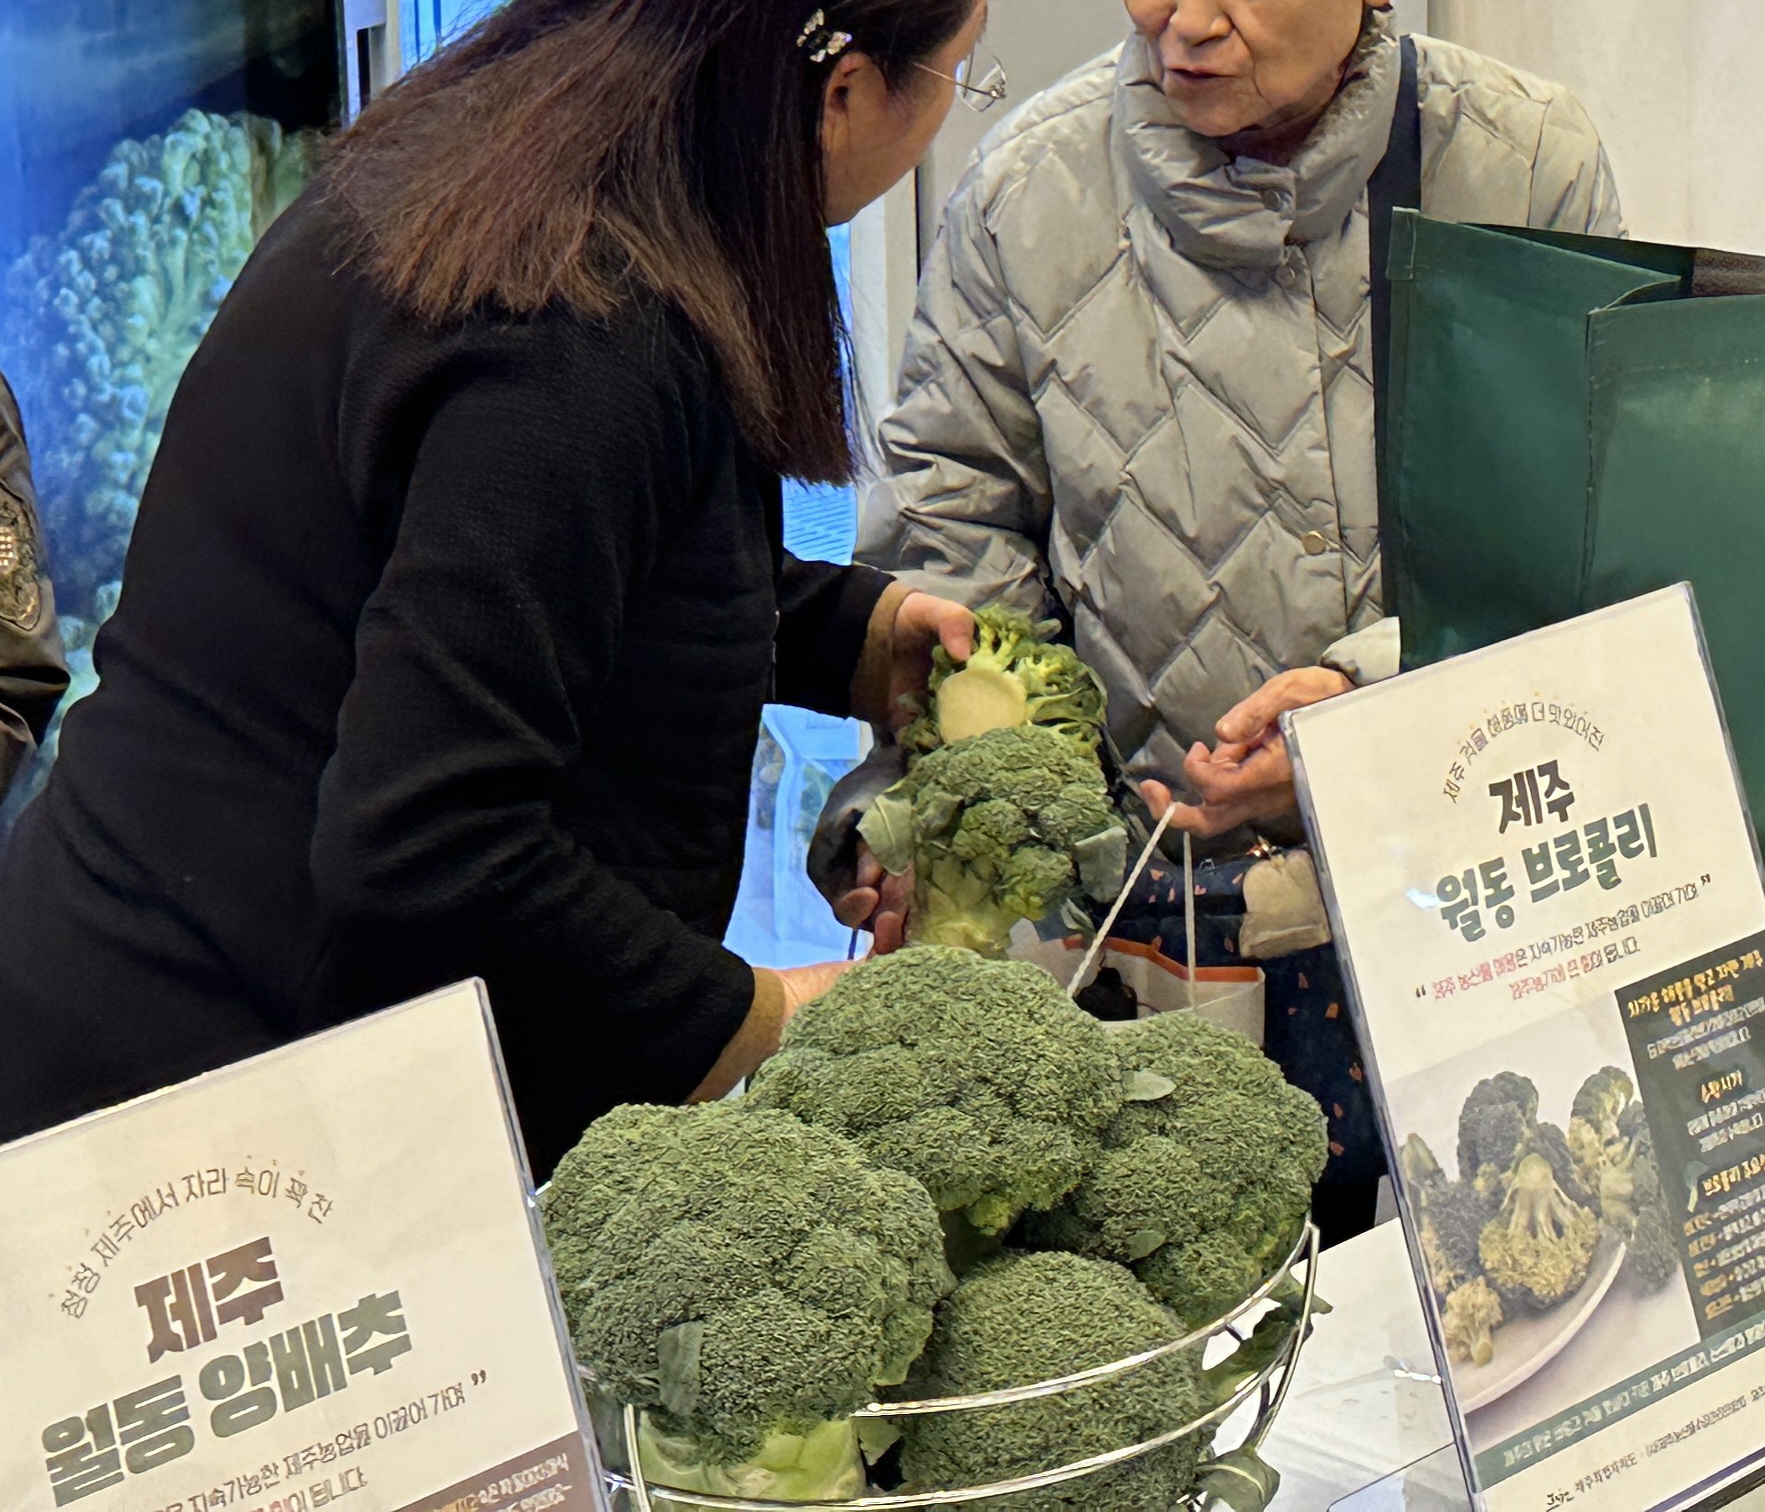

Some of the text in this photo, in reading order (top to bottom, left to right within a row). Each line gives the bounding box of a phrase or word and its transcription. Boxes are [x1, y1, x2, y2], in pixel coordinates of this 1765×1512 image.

[1488, 759, 1575, 834] 제주
[1436, 802, 1657, 942] 월동 브로콜리
[90, 1182, 179, 1267] 제주에서
[182, 1168, 229, 1202] 자라
[134, 1236, 284, 1364] 제주
[42, 1291, 411, 1508] 월동 양배추
